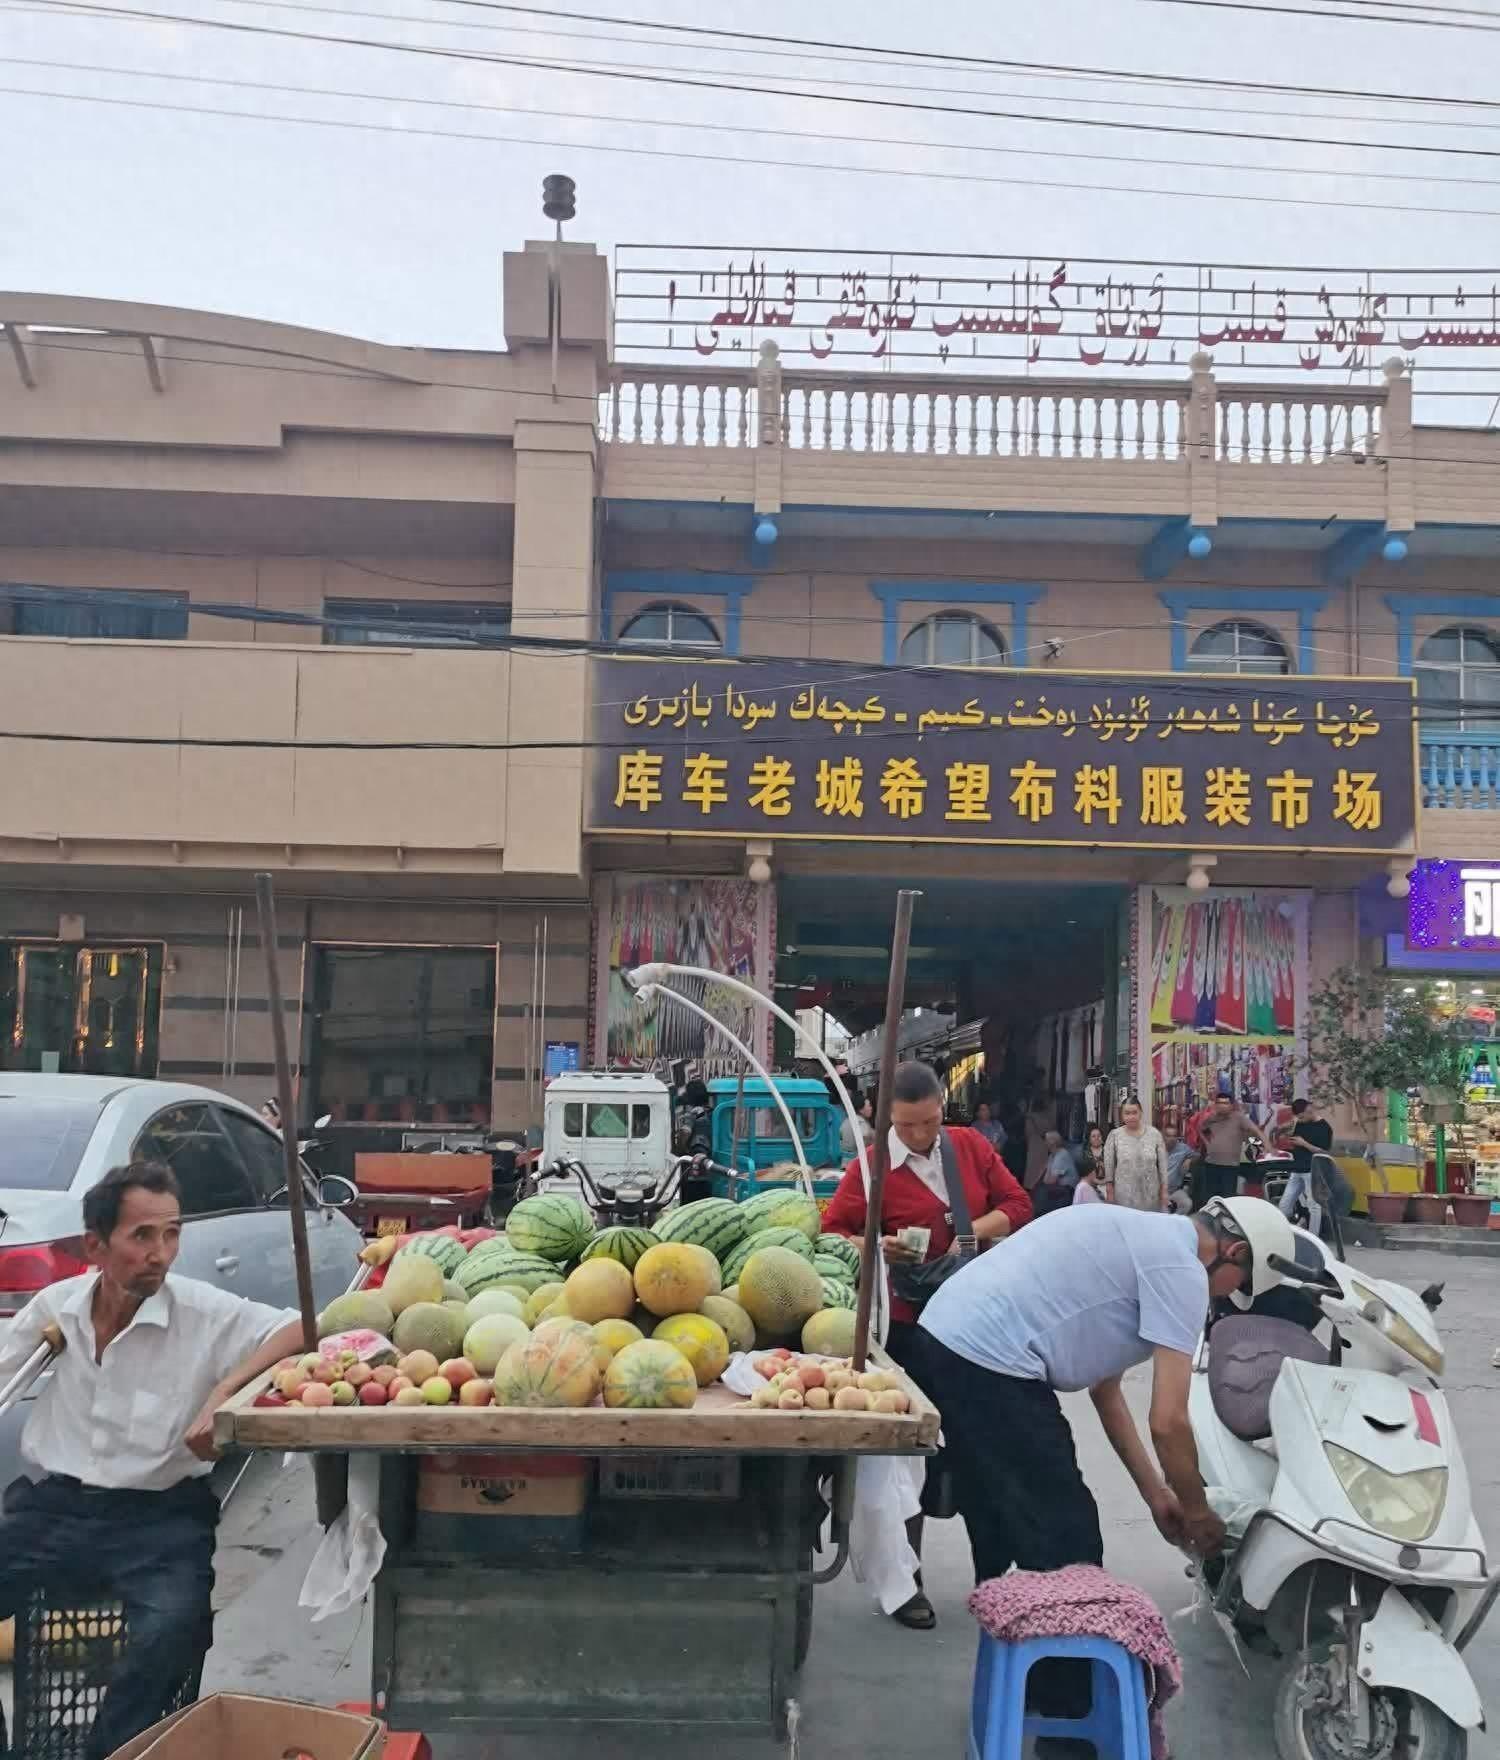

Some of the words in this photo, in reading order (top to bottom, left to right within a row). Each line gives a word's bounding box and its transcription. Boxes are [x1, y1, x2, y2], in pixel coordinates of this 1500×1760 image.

[727, 683, 777, 730] سودا
[613, 749, 1381, 830] 库车老城希望布料服装市场
